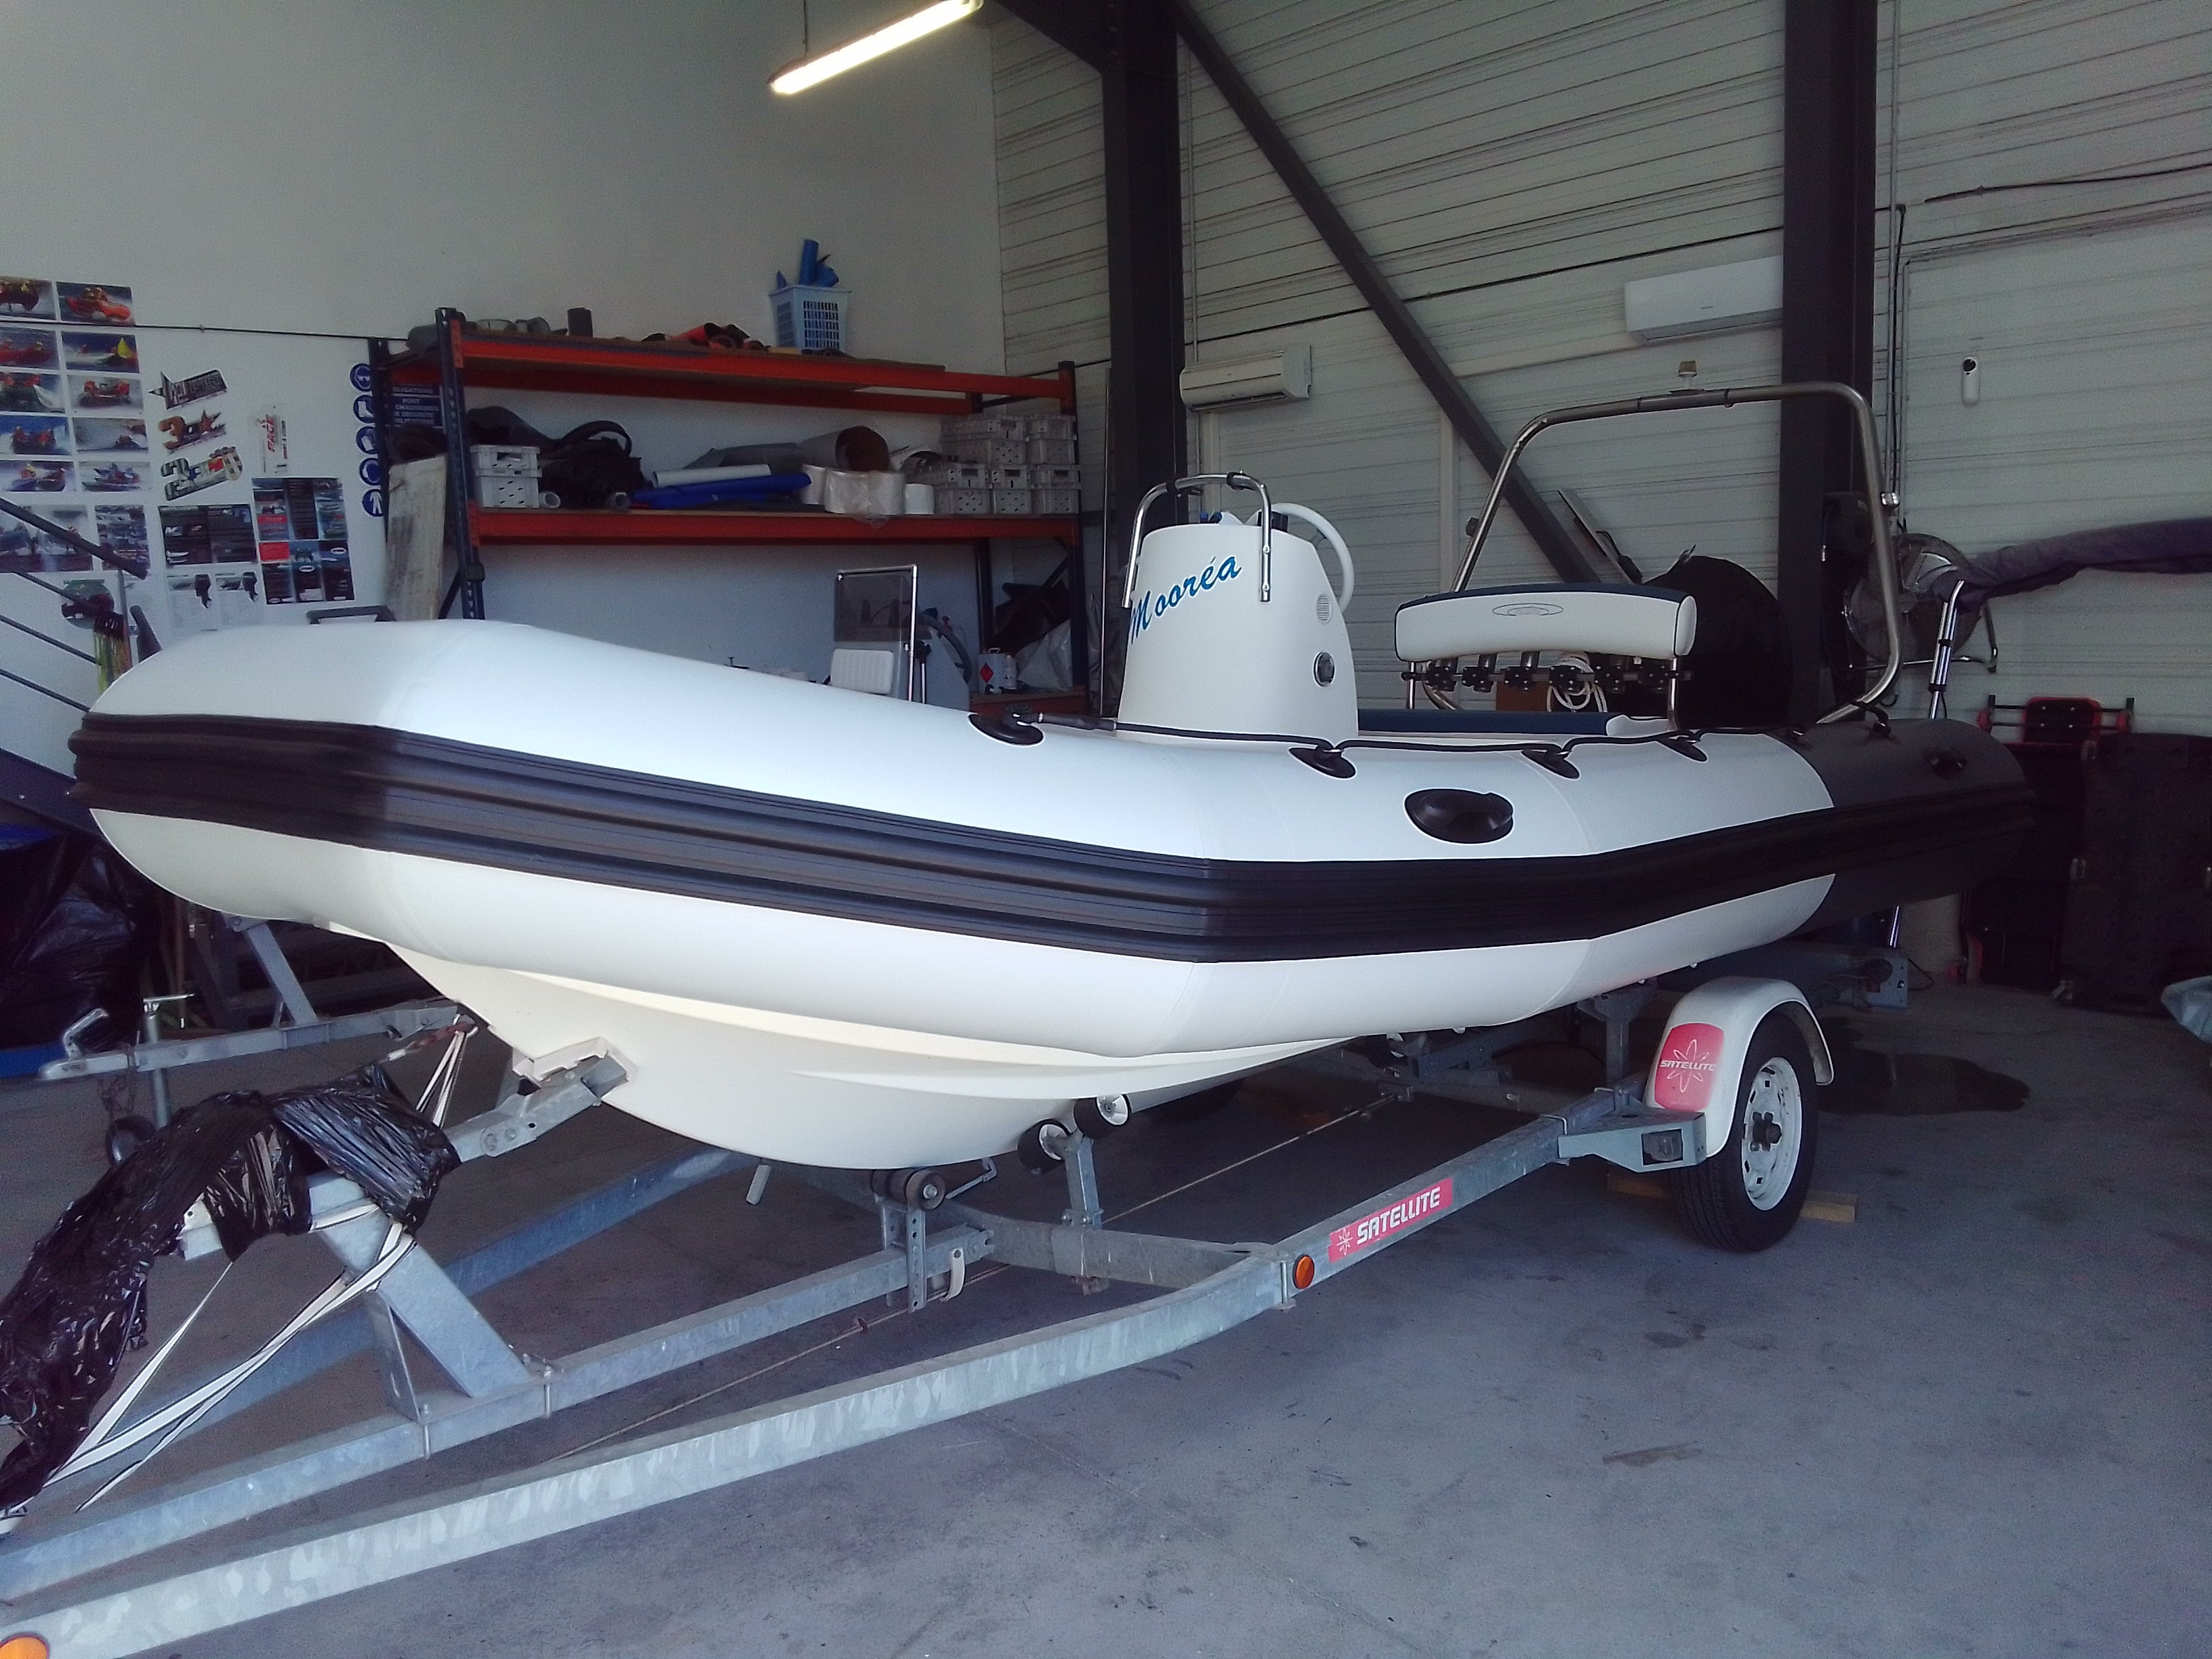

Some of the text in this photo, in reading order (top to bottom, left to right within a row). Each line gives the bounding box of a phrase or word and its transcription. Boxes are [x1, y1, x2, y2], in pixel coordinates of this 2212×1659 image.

[1130, 556, 1242, 644] Mooréa
[1660, 1061, 1716, 1071] SATELLITE
[1357, 1187, 1441, 1245] SATELLITE
